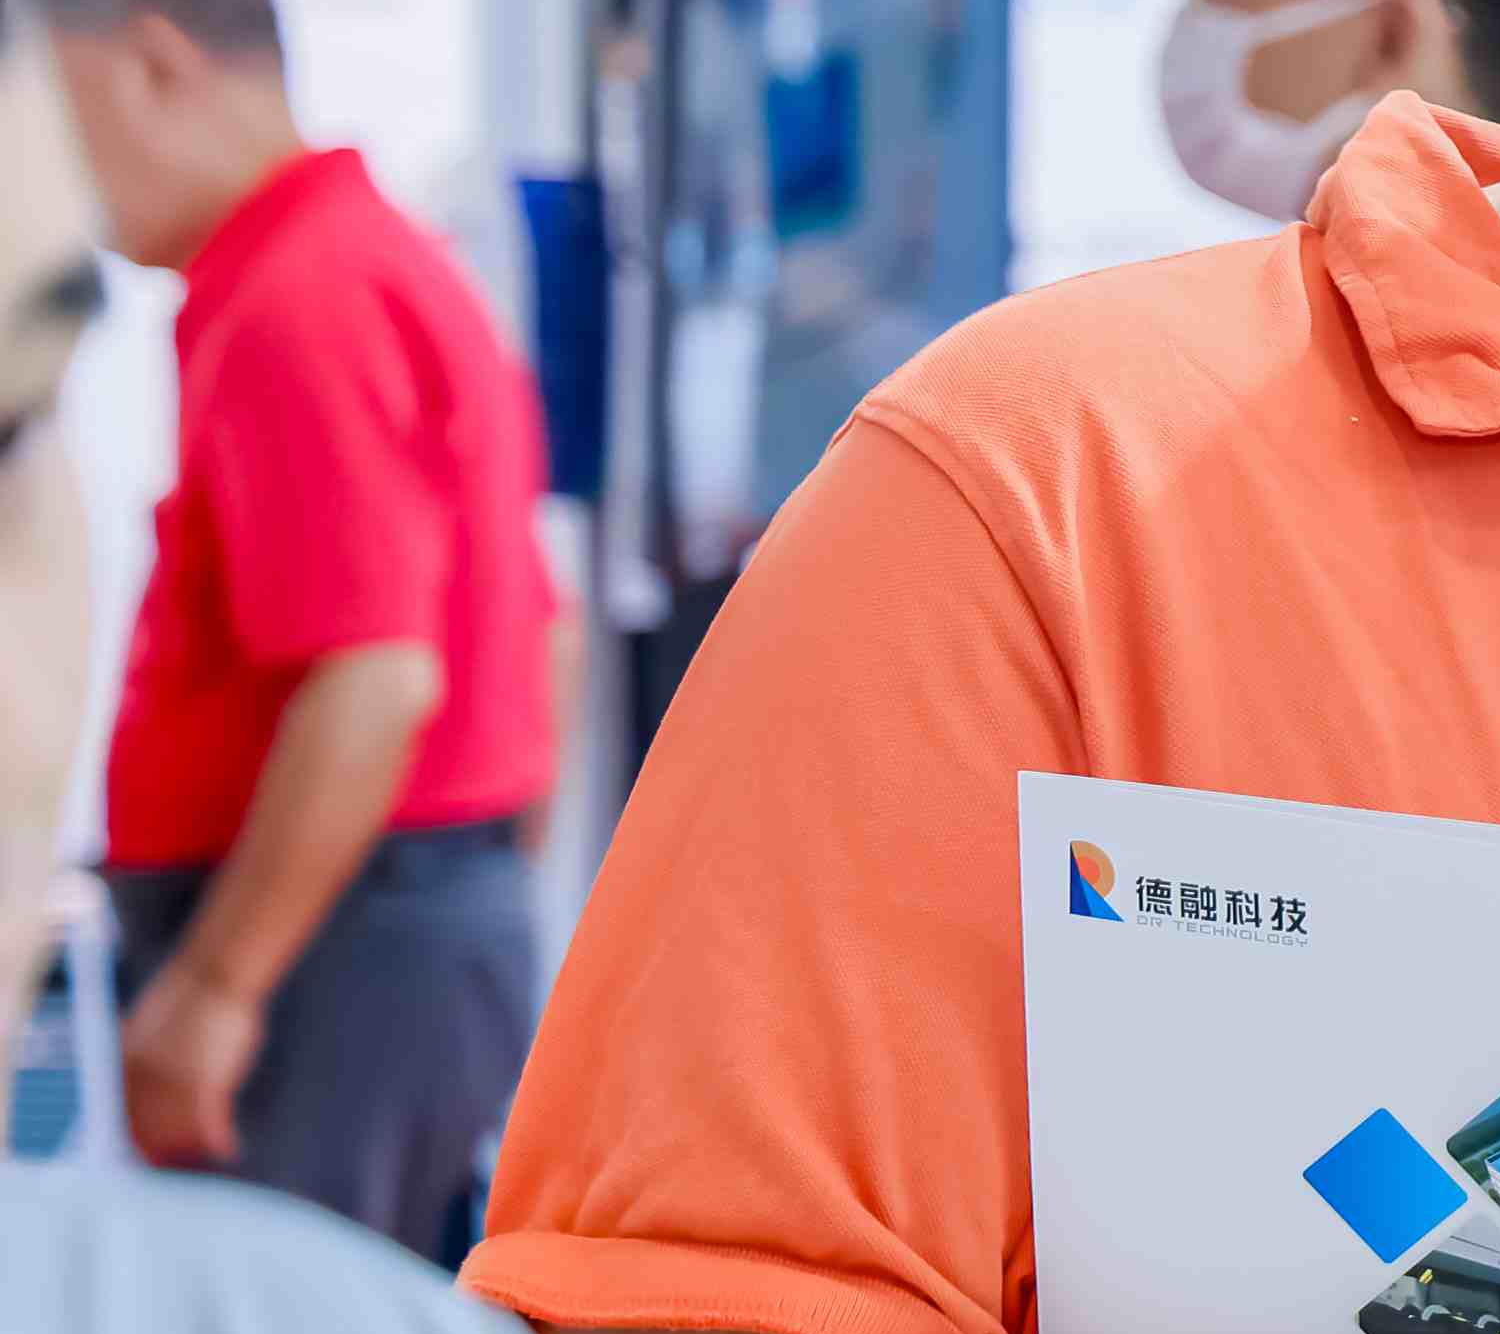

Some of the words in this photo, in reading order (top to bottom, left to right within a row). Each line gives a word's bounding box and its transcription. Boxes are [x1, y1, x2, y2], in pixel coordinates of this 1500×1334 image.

[1136, 876, 1308, 935] 德融科技
[1136, 914, 1163, 929] DR
[1175, 919, 1309, 948] TECHNOLOGY
